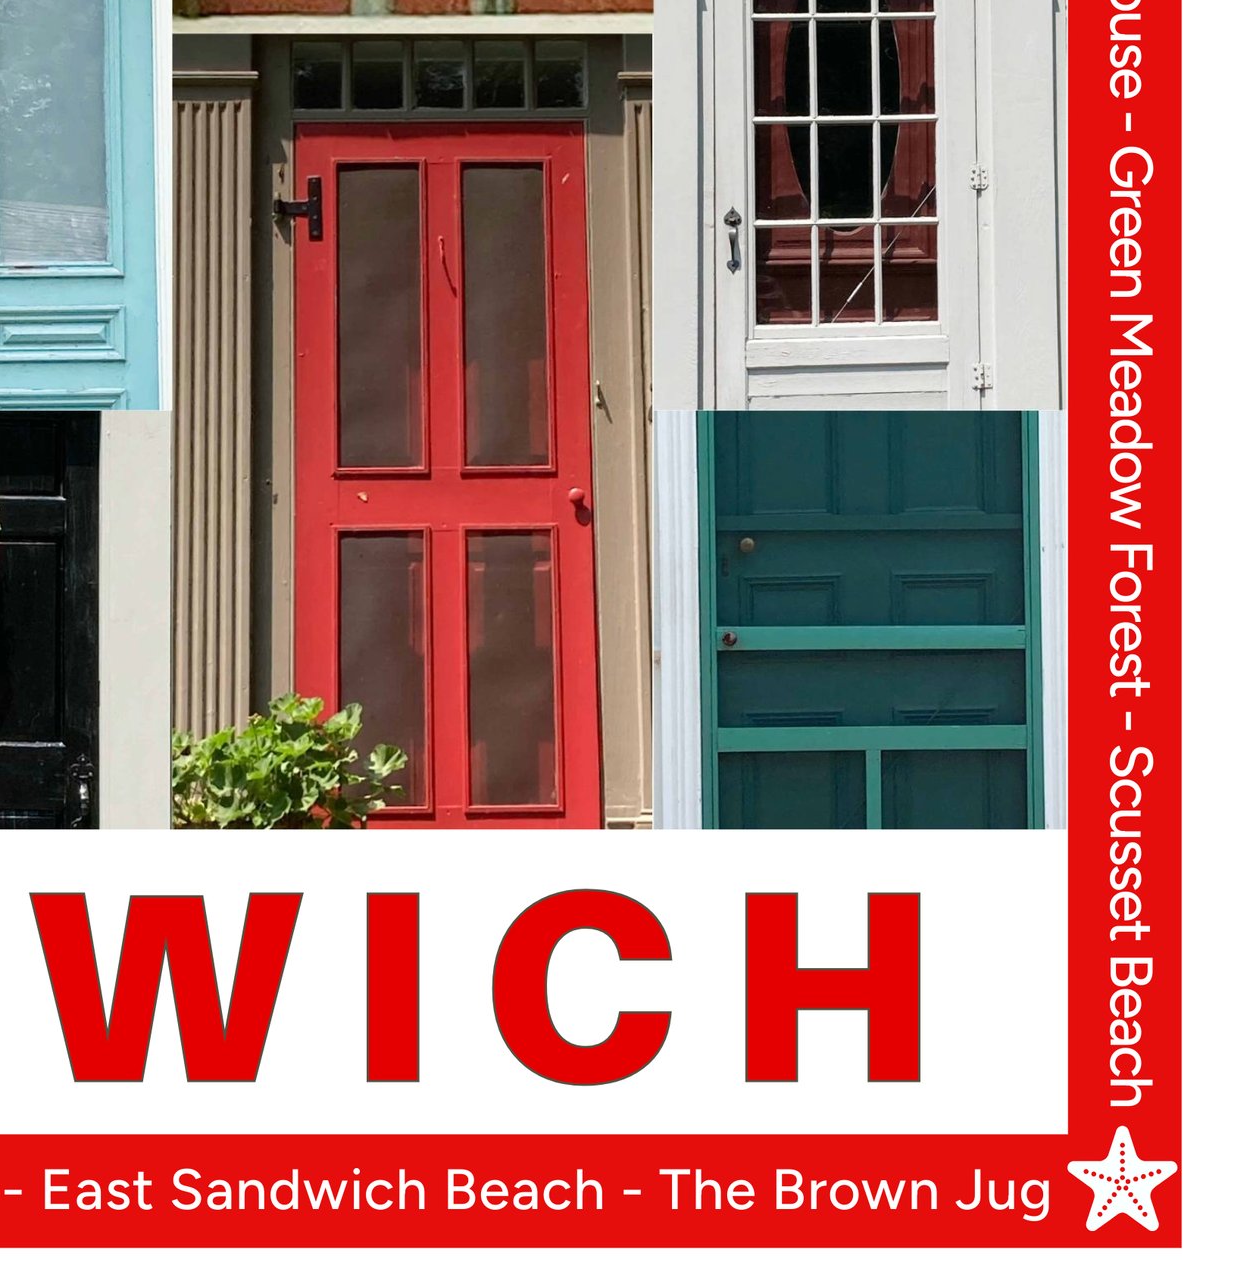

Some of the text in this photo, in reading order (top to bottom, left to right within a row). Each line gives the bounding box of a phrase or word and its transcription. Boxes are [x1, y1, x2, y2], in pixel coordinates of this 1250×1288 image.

[1109, 146, 1154, 298] Green
[1109, 314, 1154, 530] Meadow
[1109, 544, 1154, 698] Forest
[1109, 745, 1154, 942] Scusset
[1109, 957, 1154, 1107] Beach
[44, 1167, 153, 1211] East
[171, 1167, 425, 1211] Sandwich
[447, 1167, 603, 1211] Beach
[659, 1167, 755, 1211] The
[775, 1167, 938, 1211] Brown
[955, 1167, 1050, 1222] Jug
